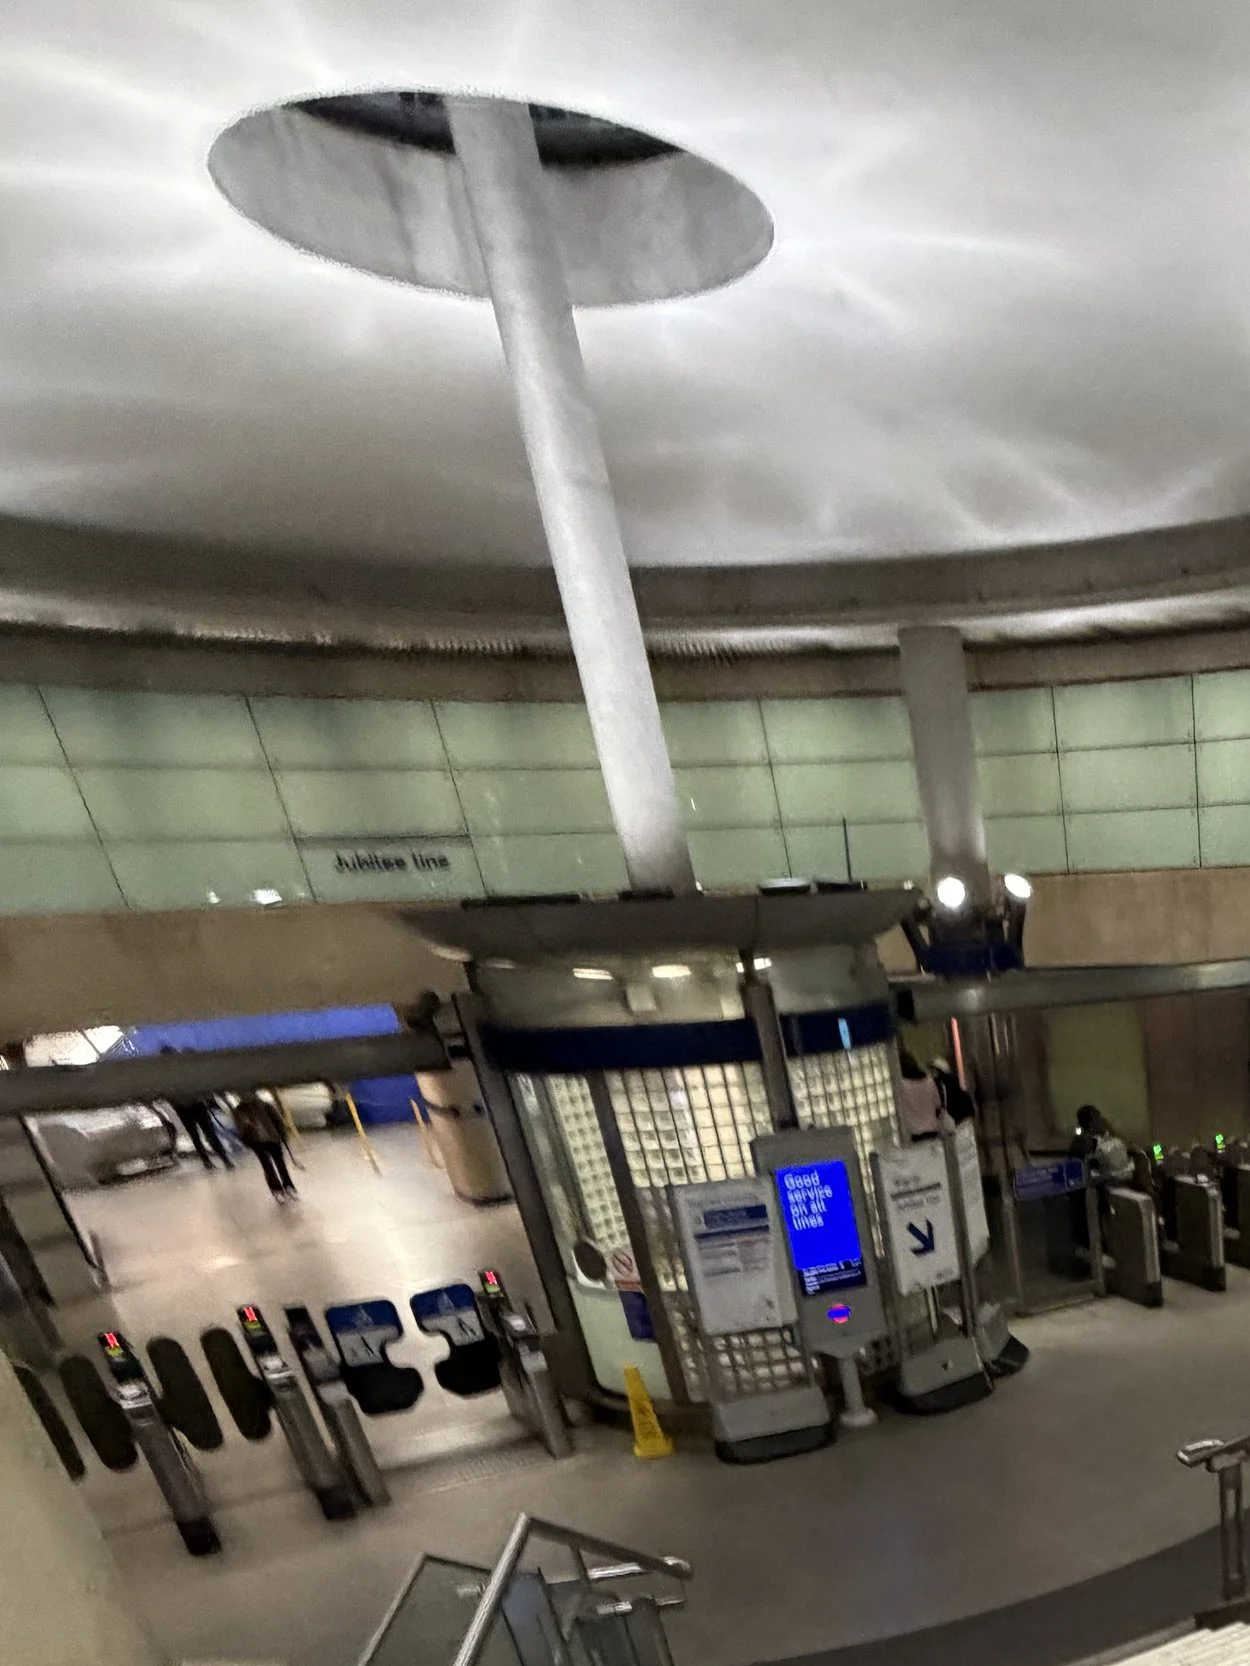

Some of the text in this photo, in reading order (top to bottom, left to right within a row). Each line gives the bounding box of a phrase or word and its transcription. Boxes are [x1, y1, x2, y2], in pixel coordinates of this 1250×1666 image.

[335, 851, 450, 873] Jubilee line
[784, 1170, 820, 1190] Good
[787, 1185, 833, 1204] service
[790, 1199, 827, 1217] on all
[792, 1213, 824, 1231] lines
